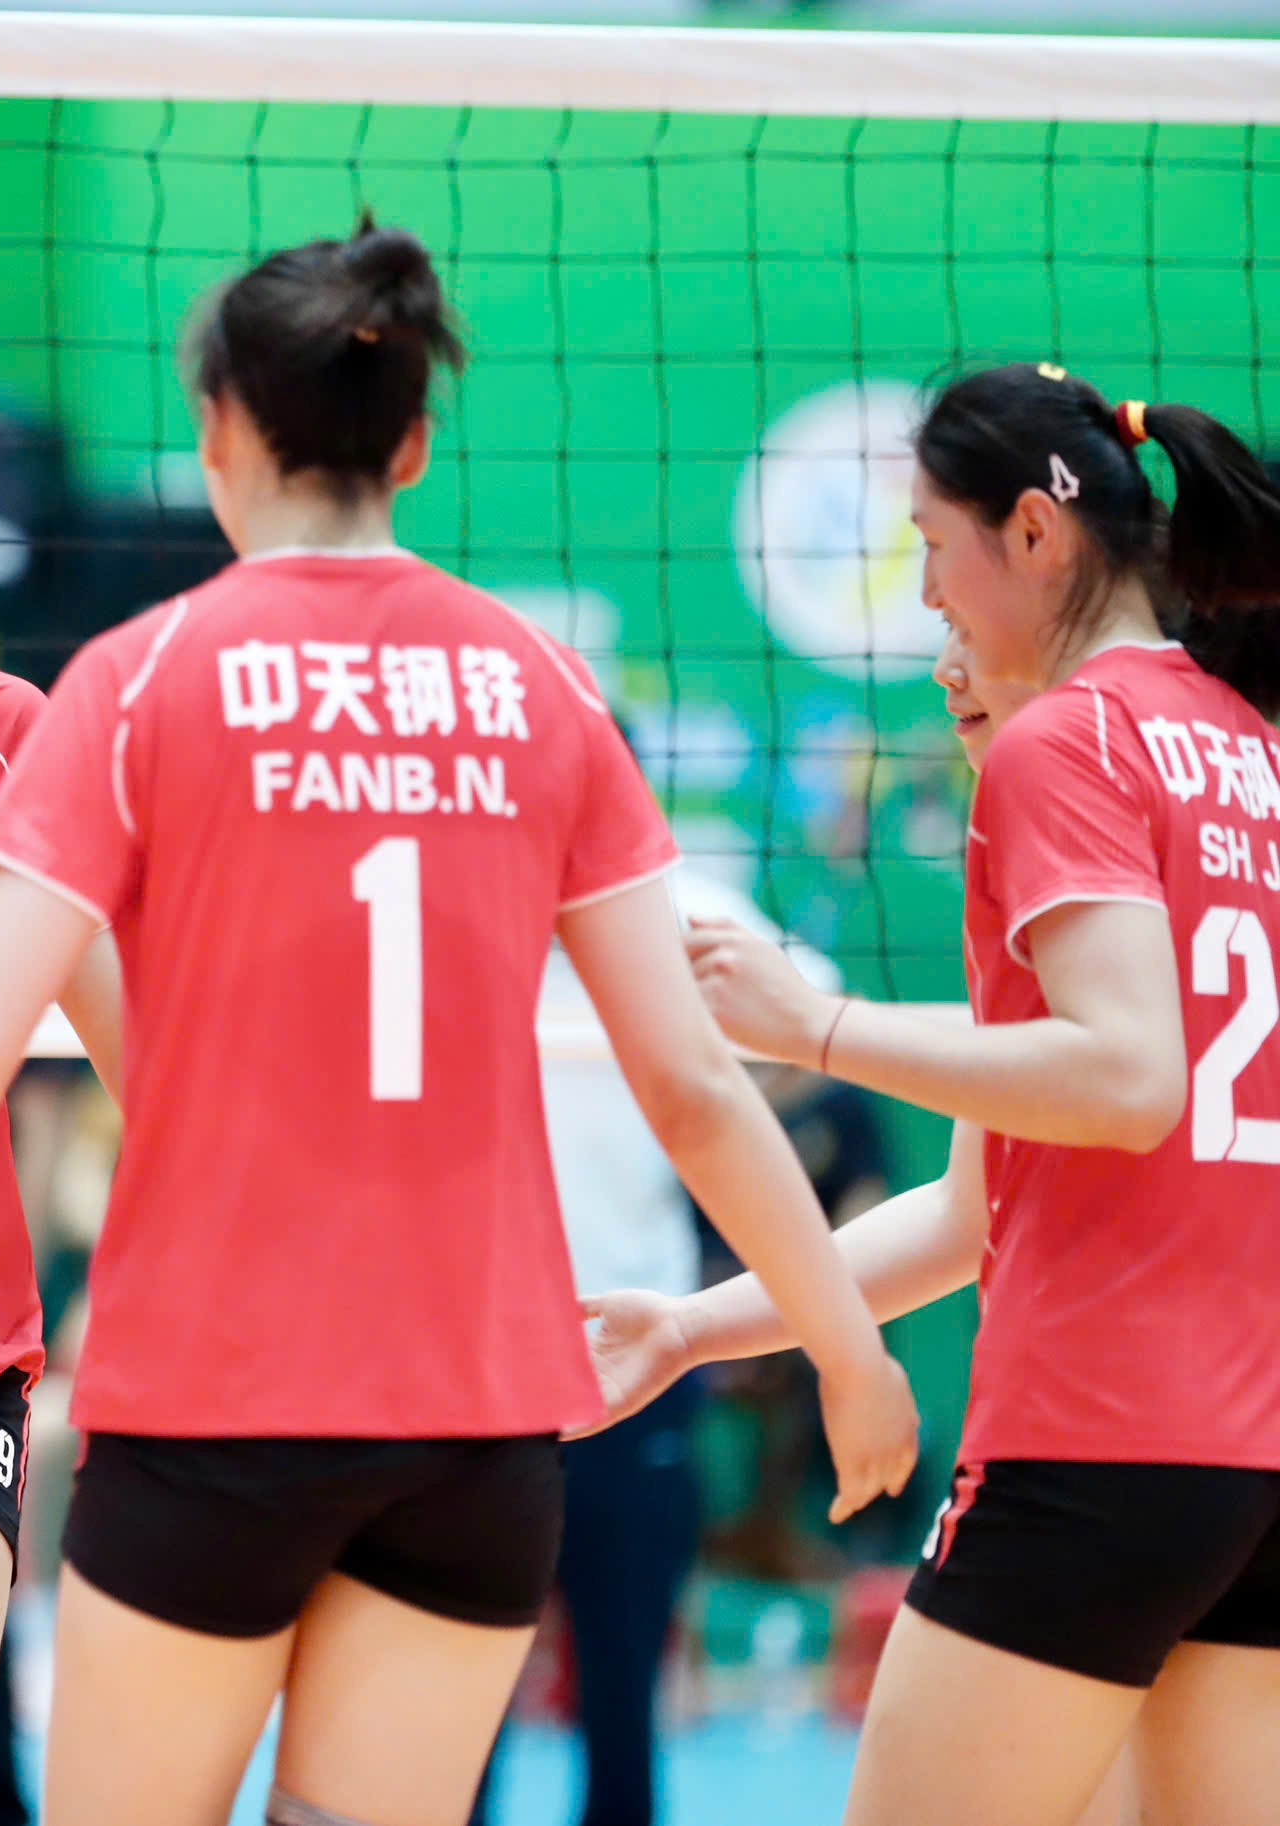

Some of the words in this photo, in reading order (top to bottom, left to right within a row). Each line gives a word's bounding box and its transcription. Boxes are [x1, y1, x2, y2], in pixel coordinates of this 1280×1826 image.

[218, 640, 529, 741] 中天钢铁
[1139, 716, 1280, 821] 中天钢
[352, 836, 423, 1101] 1
